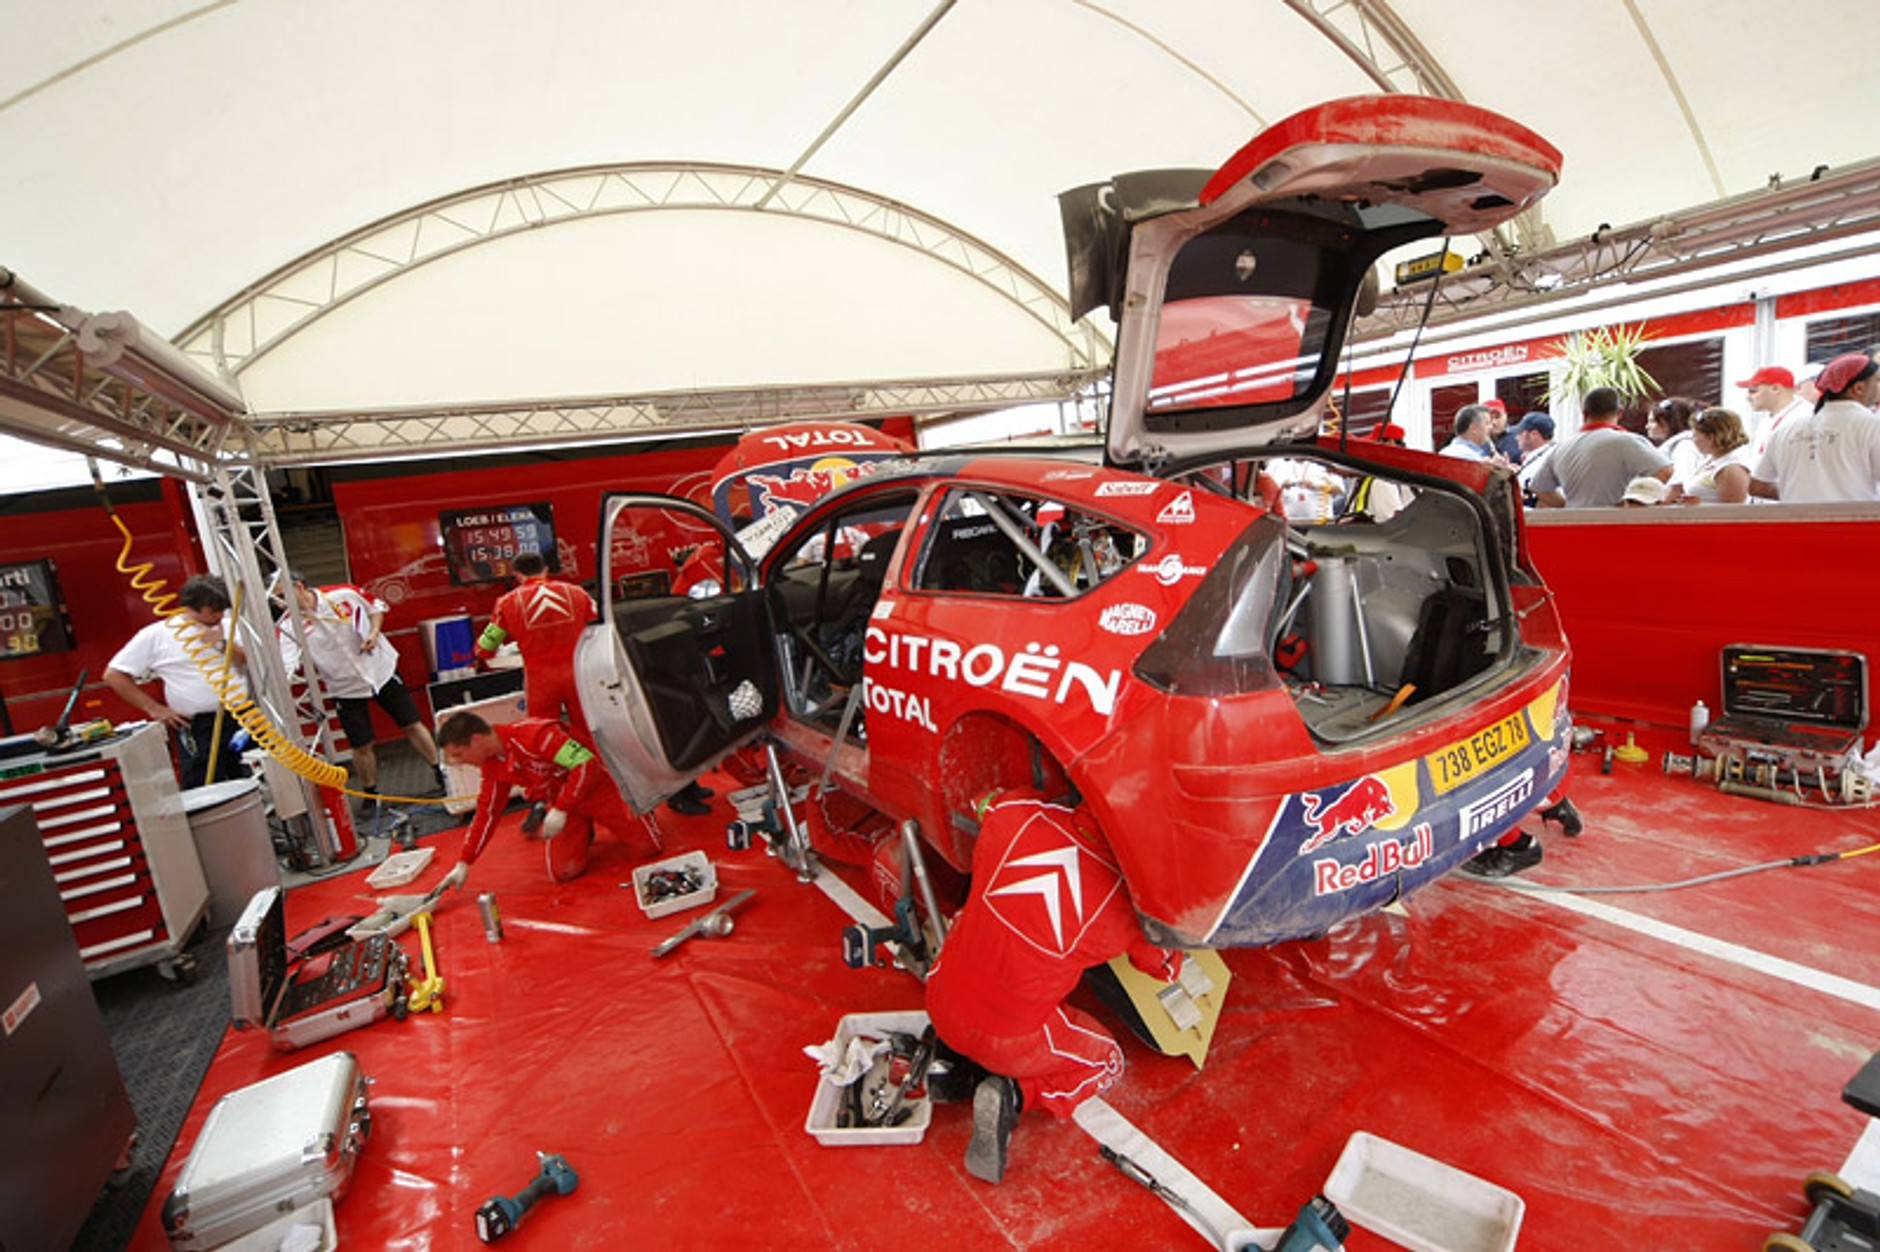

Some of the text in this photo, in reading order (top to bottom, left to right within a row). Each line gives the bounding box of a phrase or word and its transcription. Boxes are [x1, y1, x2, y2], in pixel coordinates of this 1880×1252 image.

[763, 430, 875, 450] TOTAL
[456, 516, 489, 527] LOEB
[862, 676, 939, 734] TOTAL
[863, 626, 1123, 716] CITROËN
[1436, 745, 1473, 784] 738
[1471, 725, 1508, 766] EGZ
[1505, 715, 1524, 747] 78
[1458, 766, 1534, 841] PIRELLI
[1313, 821, 1433, 896] Red Bull
